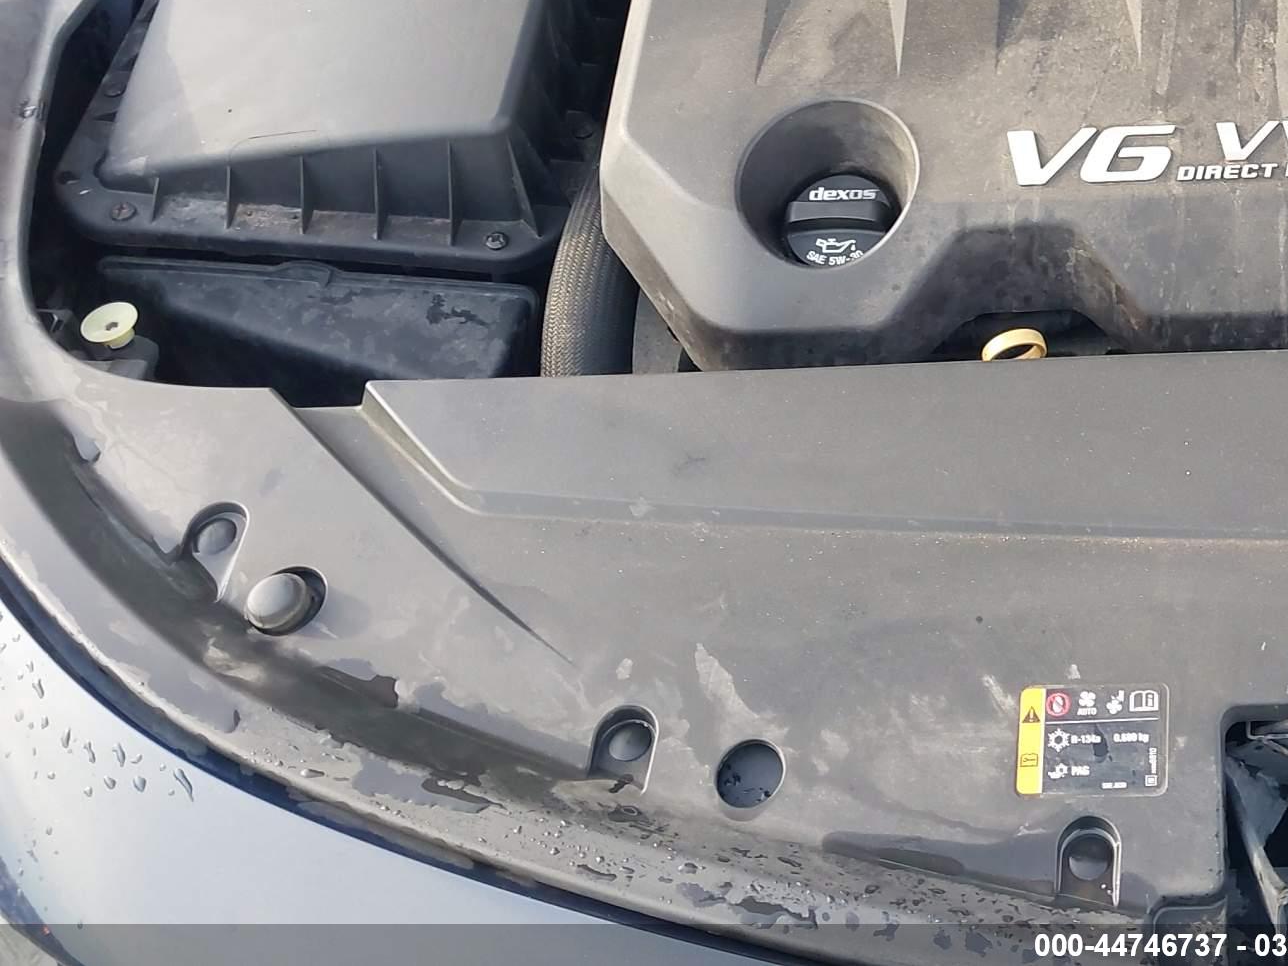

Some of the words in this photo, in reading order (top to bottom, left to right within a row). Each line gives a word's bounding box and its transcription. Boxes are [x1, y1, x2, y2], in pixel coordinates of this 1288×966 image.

[1007, 124, 1176, 185] V6
[1176, 161, 1280, 181] DIRECT
[808, 186, 881, 201] dexos
[806, 250, 828, 265] SAE
